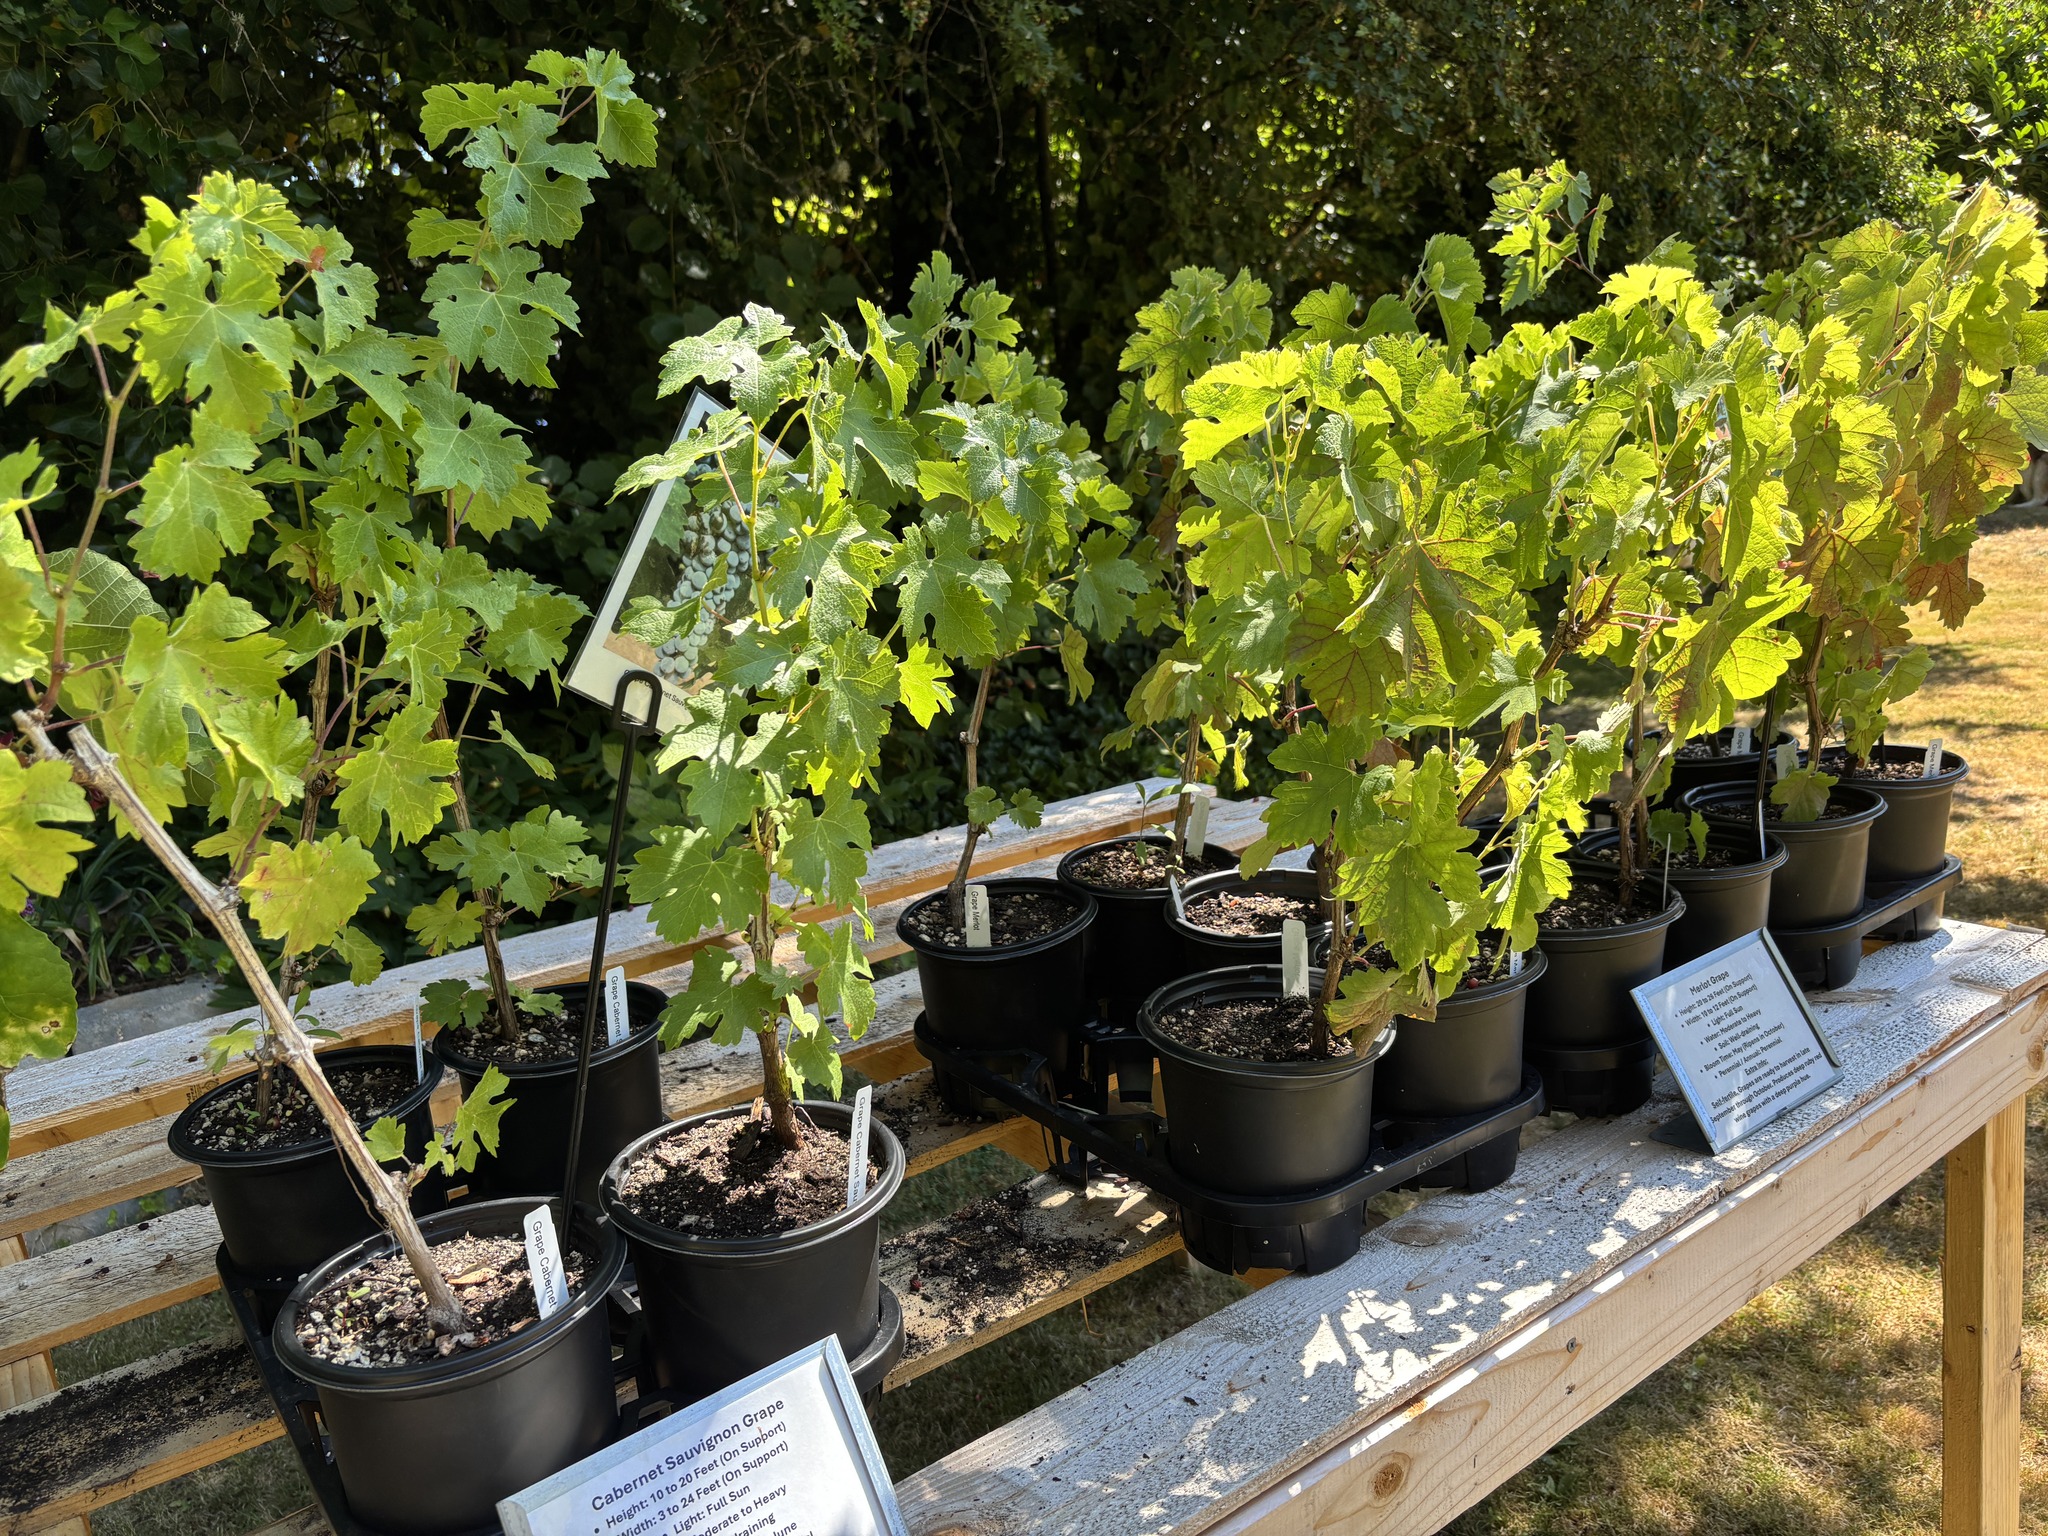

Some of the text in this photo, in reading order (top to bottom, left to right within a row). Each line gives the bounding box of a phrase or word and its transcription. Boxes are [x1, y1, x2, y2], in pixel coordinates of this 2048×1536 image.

[970, 891, 979, 910] Grape
[611, 976, 619, 1000] Grape
[1689, 971, 1729, 995] Merlot Grape
[613, 1002, 621, 1037] Cabernet
[1678, 1004, 1697, 1016] Height:
[1713, 988, 1725, 998] Feet
[1684, 1014, 1702, 1026] Width:
[1717, 999, 1730, 1008] Feet
[1711, 1015, 1726, 1026] Light:
[1723, 1009, 1734, 1019] Full
[1704, 1031, 1721, 1043] Water:
[1719, 1020, 1742, 1035] Moderate
[1745, 1009, 1761, 1020] Heavy
[1718, 1023, 1760, 1049] Soil: Well-draining
[1704, 1059, 1721, 1071] Bloom
[1718, 1052, 1734, 1063] Time:
[1742, 1037, 1760, 1051] (Ripens
[1763, 1022, 1785, 1037] October)
[1718, 1060, 1742, 1077] Perennial
[1743, 1049, 1762, 1064] Annual:
[1760, 1036, 1782, 1053] Perennial
[1735, 1094, 1754, 1108] through
[1753, 1083, 1774, 1097] October.
[1772, 1070, 1794, 1086] Produces
[1793, 1064, 1805, 1074] deep
[1804, 1058, 1815, 1067] ruby
[1737, 1080, 1755, 1093] Grapes
[1762, 1068, 1776, 1079] ready
[1779, 1055, 1797, 1068] harvest
[1799, 1047, 1810, 1056] late
[1744, 1065, 1758, 1076] Extra
[857, 1096, 866, 1127] Grape
[1734, 1113, 1747, 1123] wine
[1746, 1103, 1762, 1117] grapes
[1761, 1096, 1772, 1106] with
[1775, 1088, 1787, 1098] deep
[1785, 1079, 1801, 1093] purple
[1799, 1074, 1811, 1082] hue.
[855, 1131, 863, 1179] Cabernet
[532, 1220, 558, 1308] Grape Cabernet
[592, 1400, 784, 1511] Cabernet Sauvignon Grape
[606, 1421, 786, 1529] Height: 10 to 20 Feet (On Support)
[658, 1510, 666, 1521] 3
[666, 1505, 679, 1516] to
[680, 1493, 695, 1509] 24
[695, 1479, 721, 1500] Feet
[722, 1469, 742, 1487] (On
[742, 1440, 788, 1472] Support)
[673, 1486, 750, 1534] Light: Full Sun
[740, 1506, 752, 1517] to
[753, 1485, 786, 1509] Heavy
